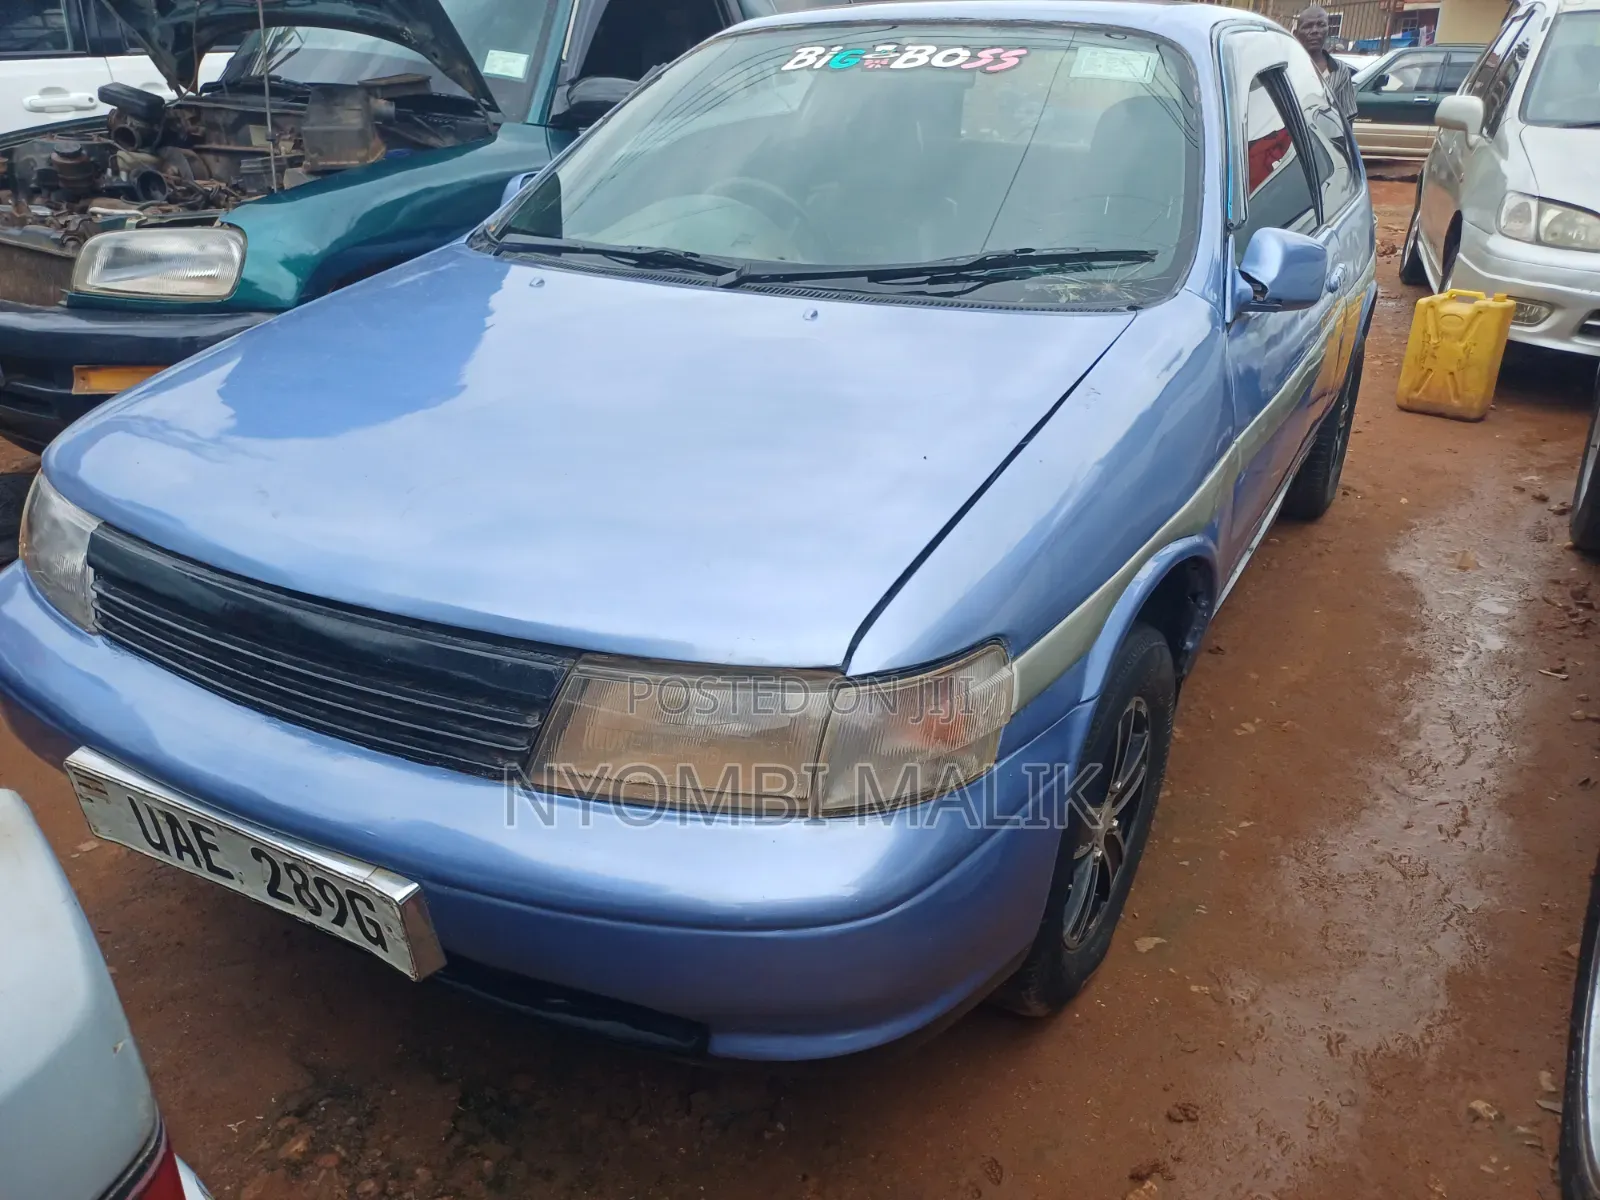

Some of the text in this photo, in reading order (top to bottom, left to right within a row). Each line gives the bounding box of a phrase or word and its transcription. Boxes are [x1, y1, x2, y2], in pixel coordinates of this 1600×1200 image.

[889, 45, 1027, 71] BOSS
[127, 795, 388, 953] UAE 289G
